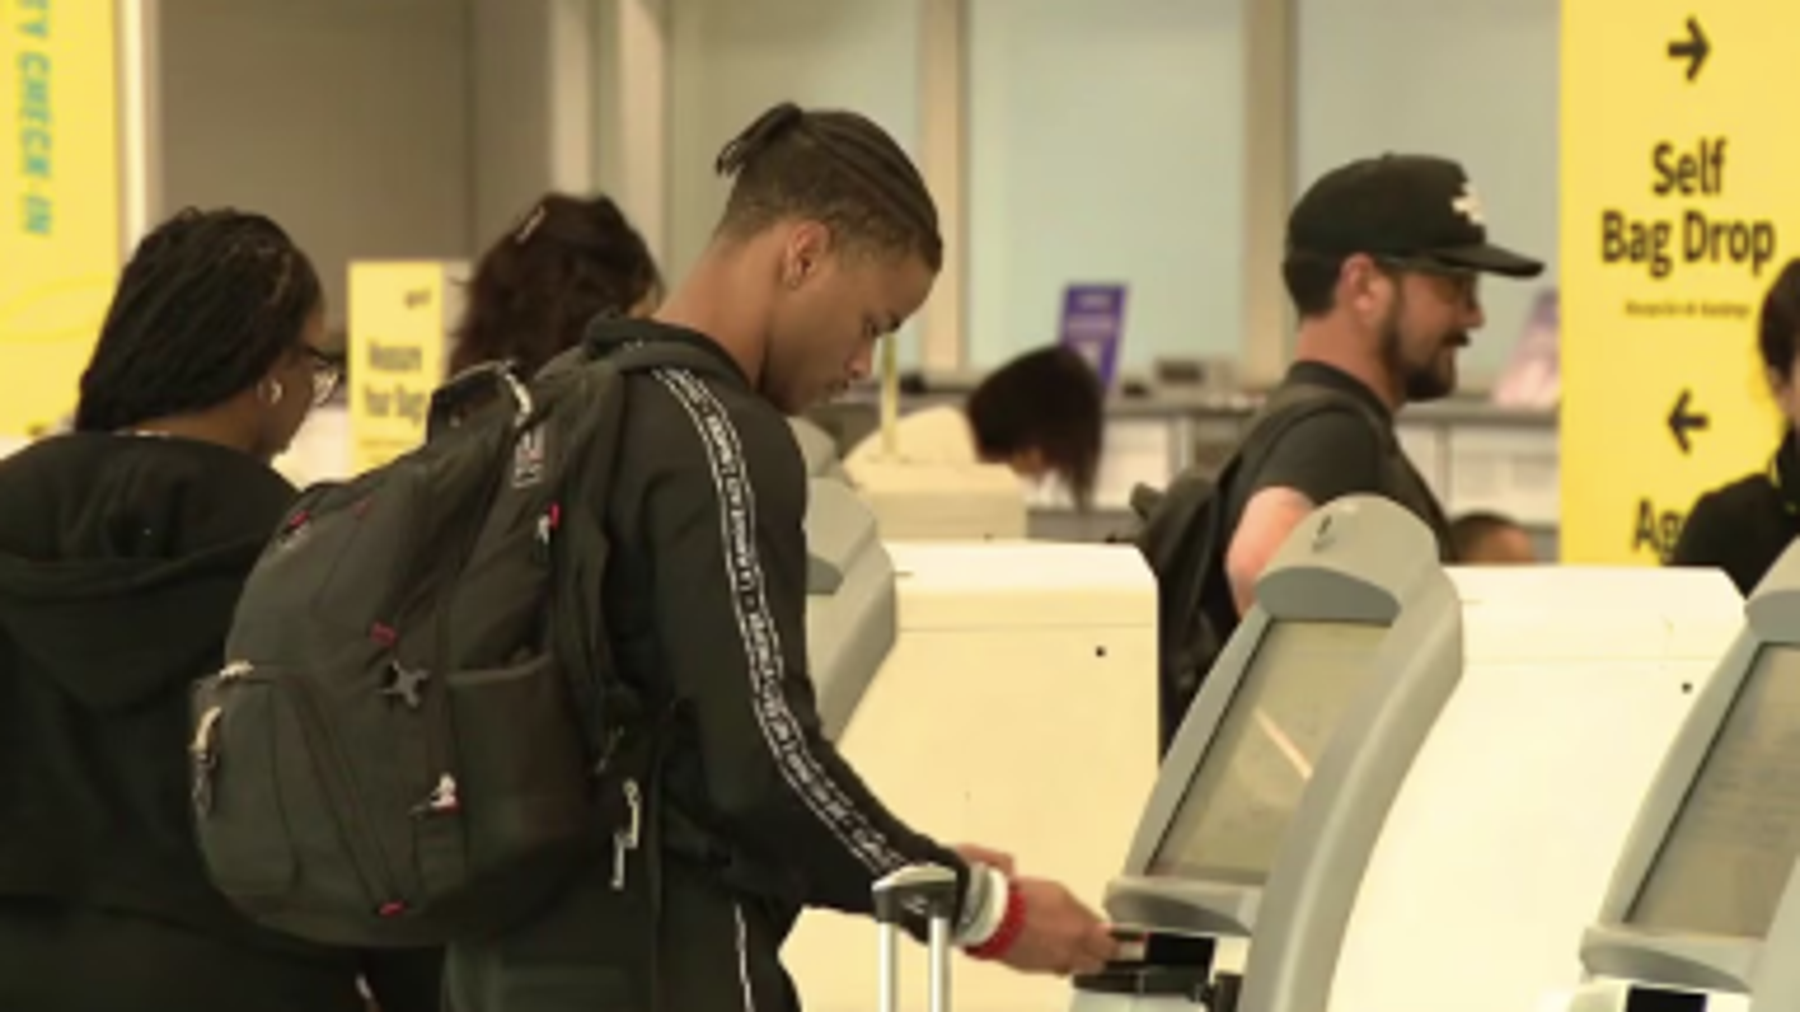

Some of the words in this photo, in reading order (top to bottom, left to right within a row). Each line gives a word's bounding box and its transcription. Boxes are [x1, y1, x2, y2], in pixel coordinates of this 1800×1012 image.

[19, 52, 51, 178] CHECK
[1652, 138, 1727, 197] Self
[22, 194, 52, 236] IN
[1601, 209, 1673, 280] Bag
[1682, 209, 1777, 277] Drop
